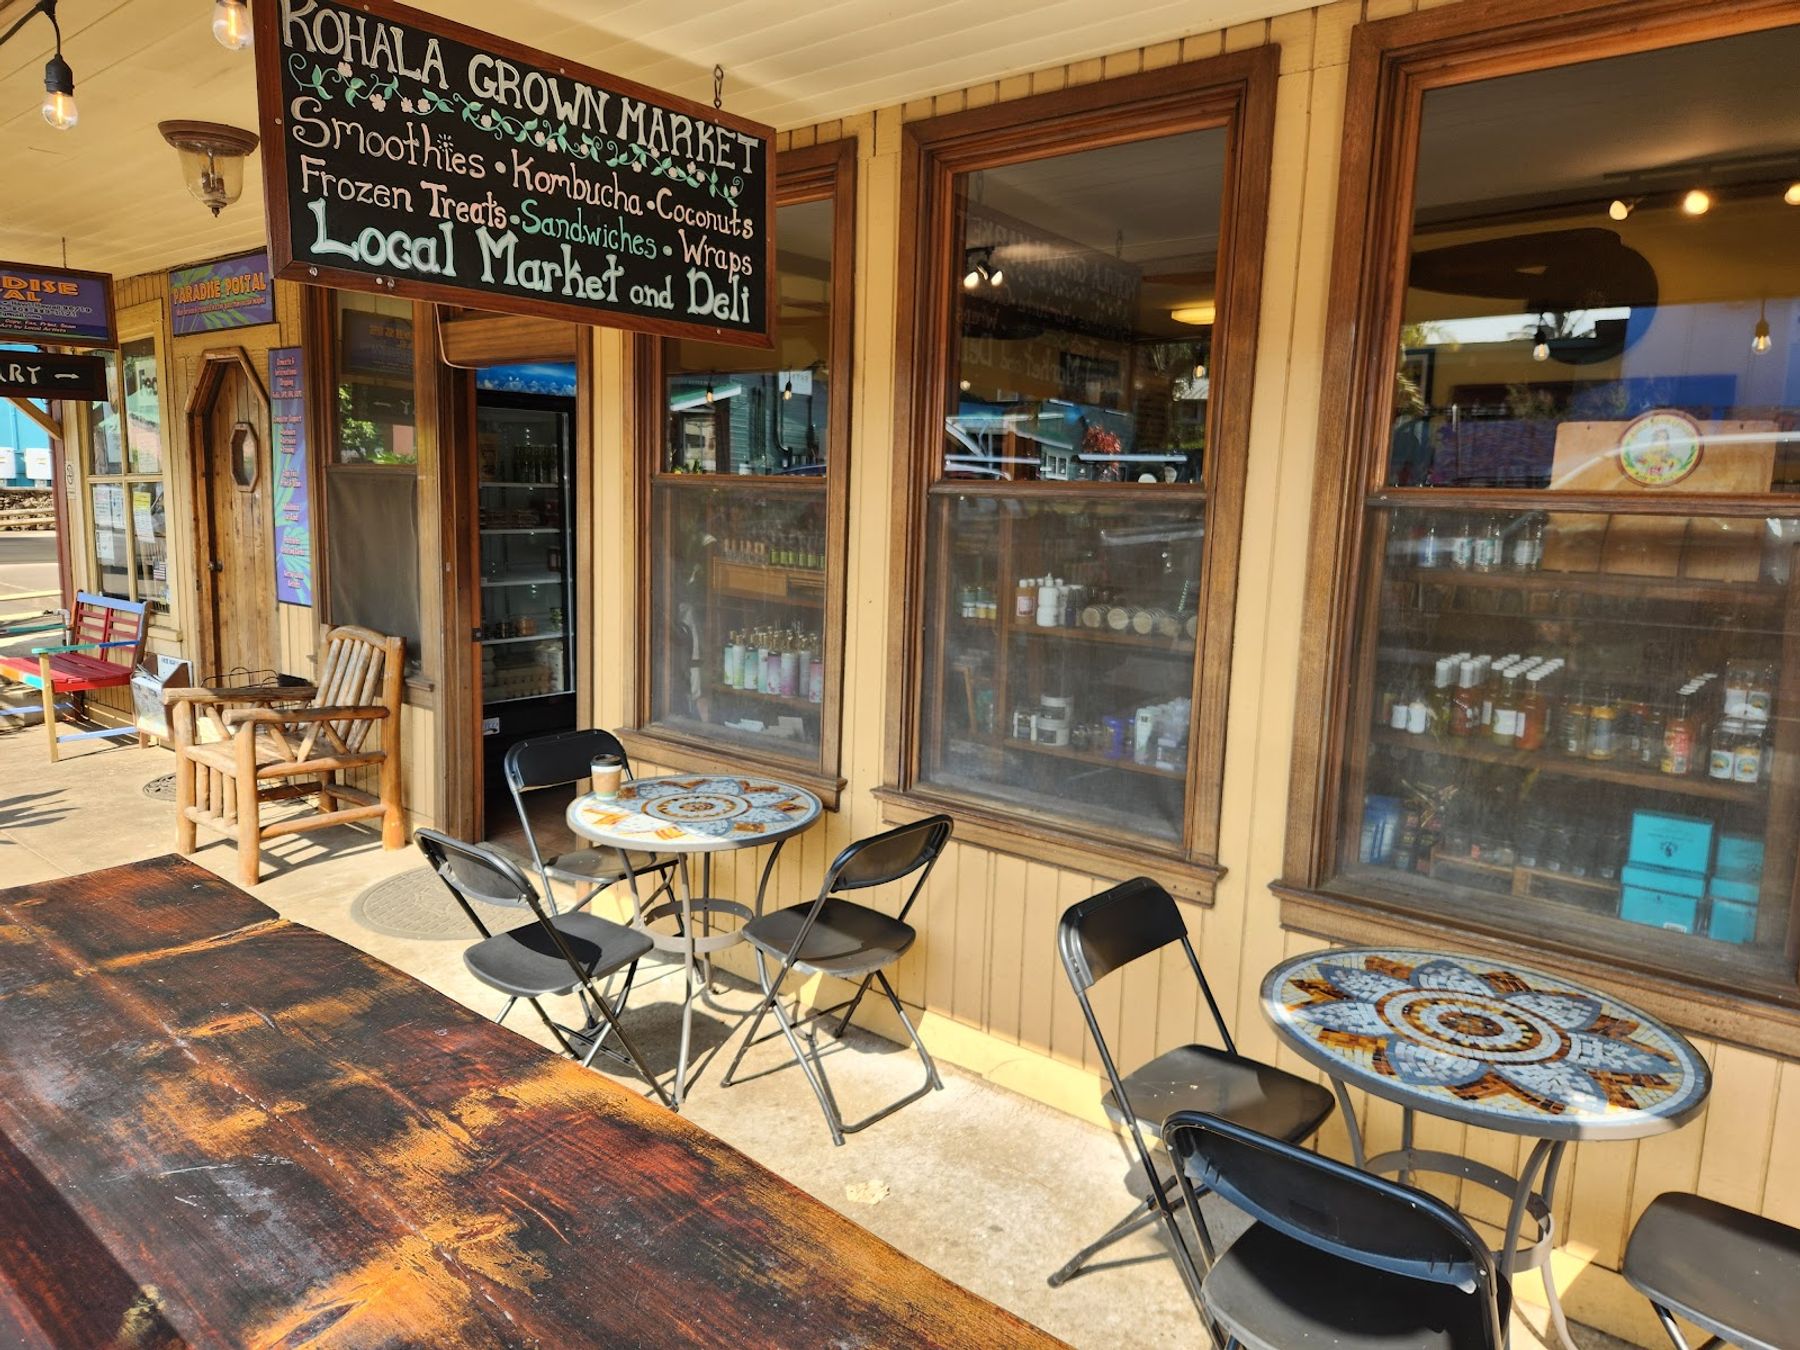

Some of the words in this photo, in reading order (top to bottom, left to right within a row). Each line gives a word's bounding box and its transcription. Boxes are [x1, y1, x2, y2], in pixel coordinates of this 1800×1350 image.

[281, 0, 450, 89] KOHALA
[468, 54, 610, 134] GROWN
[616, 103, 761, 174] MARKET
[291, 96, 486, 179] Smoothies
[511, 148, 643, 216] Kombucha
[656, 187, 754, 240] Coconuts
[300, 154, 413, 213] Frozen
[420, 180, 508, 230] Treats
[520, 199, 657, 260] Sandwiches
[678, 229, 753, 283] Wraps
[0, 288, 42, 302] AL
[306, 198, 457, 278] Local
[475, 225, 625, 304] Market
[629, 275, 675, 311] and
[686, 267, 751, 325] Deli
